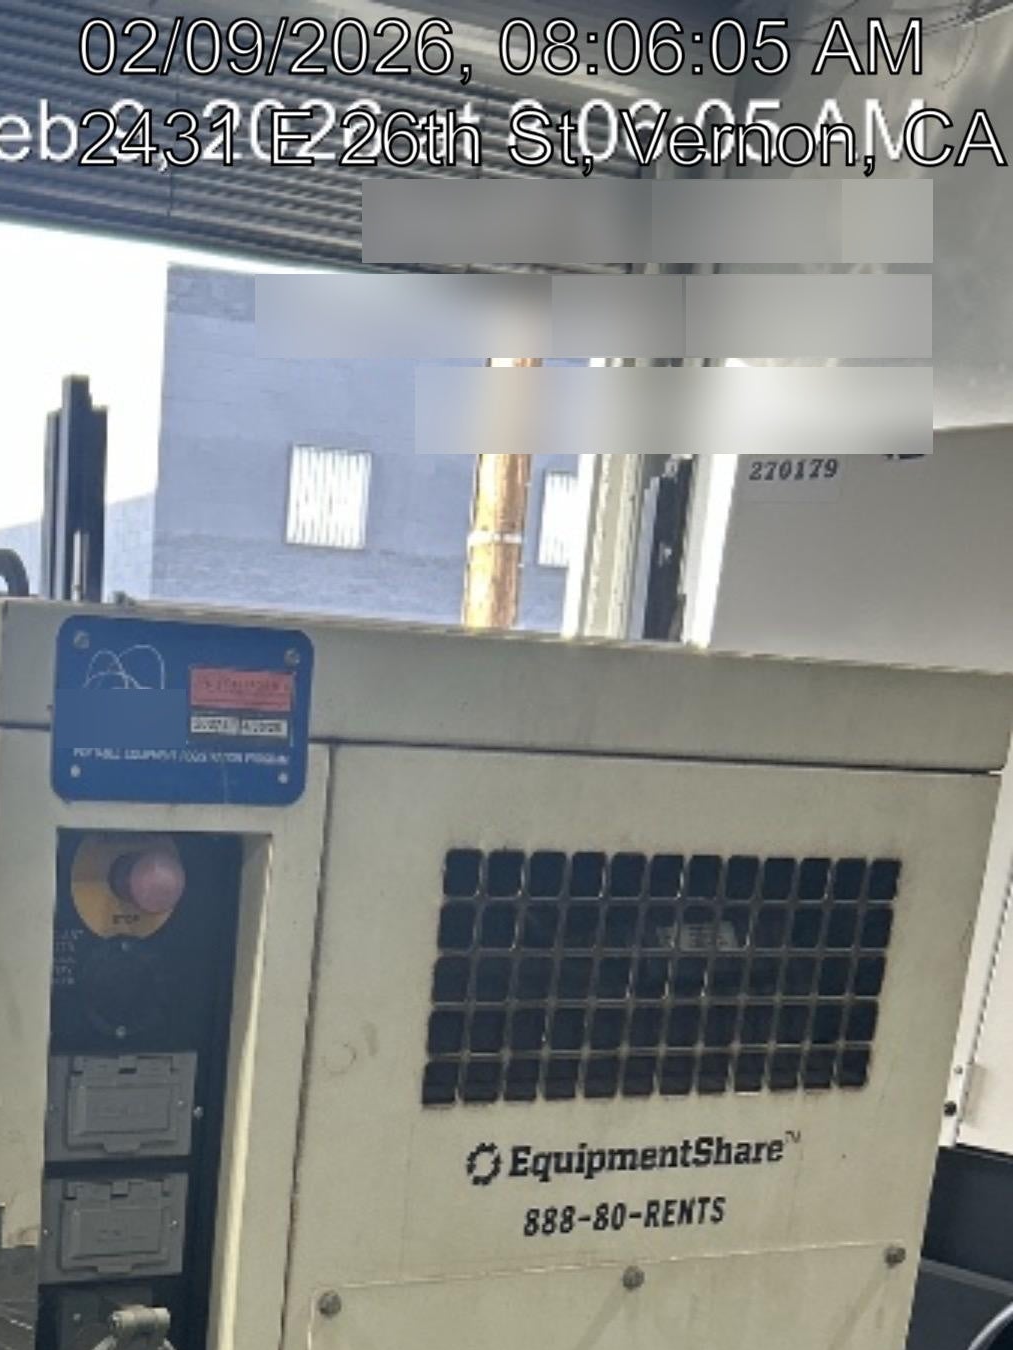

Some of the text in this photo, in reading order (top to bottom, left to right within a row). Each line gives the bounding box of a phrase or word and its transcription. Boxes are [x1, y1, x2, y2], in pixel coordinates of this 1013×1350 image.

[748, 458, 839, 481] 270179
[508, 1137, 785, 1183] EquipmentShare
[524, 1196, 726, 1236] 888-80-RENTS
